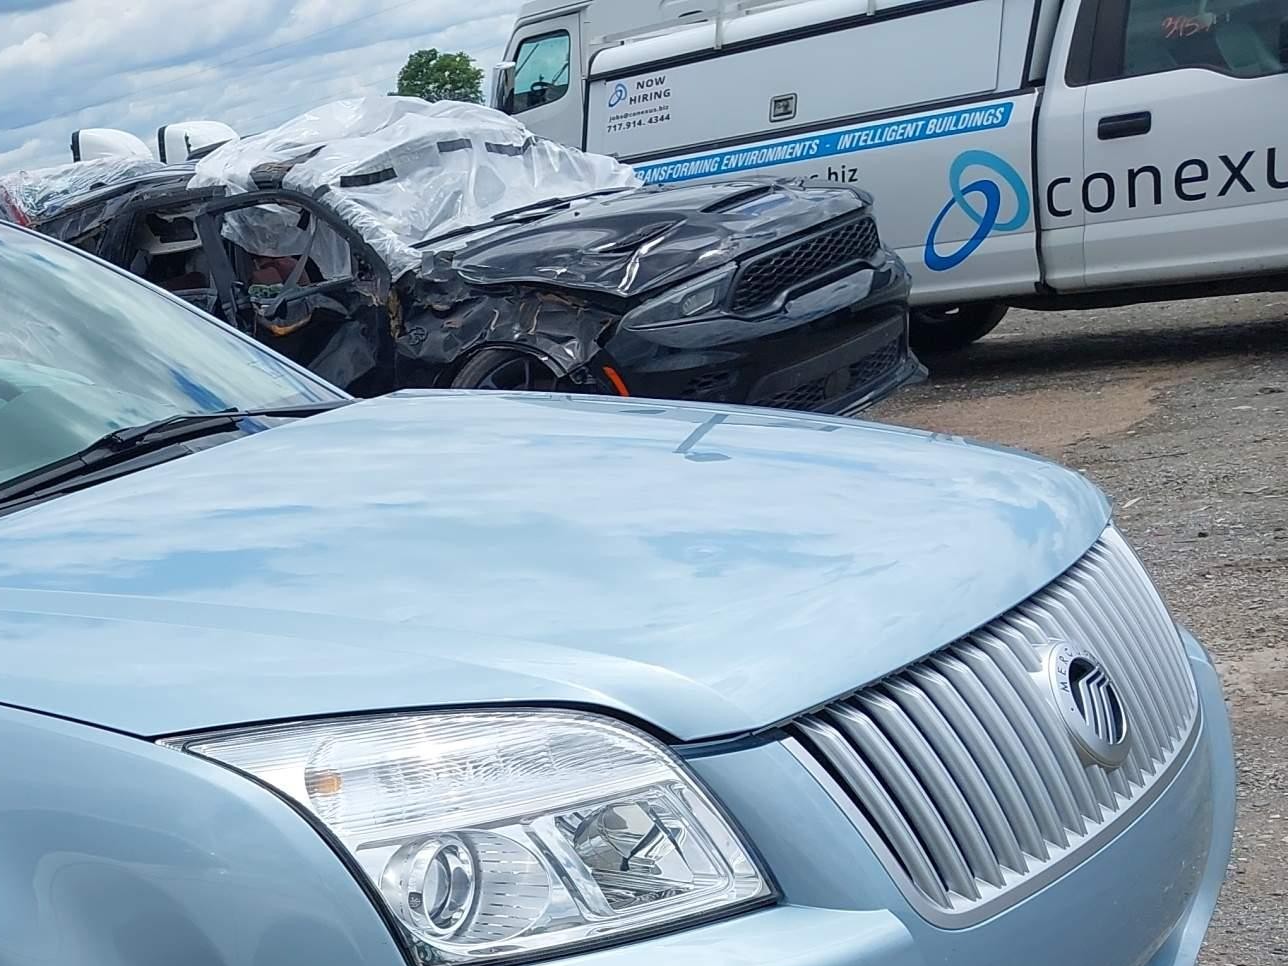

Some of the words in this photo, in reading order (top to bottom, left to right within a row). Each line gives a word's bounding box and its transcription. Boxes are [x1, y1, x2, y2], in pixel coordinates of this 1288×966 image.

[636, 76, 666, 90] NOW
[629, 88, 671, 105] HIRING
[721, 139, 819, 170] ENVIRONMENTS
[837, 120, 926, 150] INTELLIGENT
[926, 107, 1005, 135] BUILDINGS
